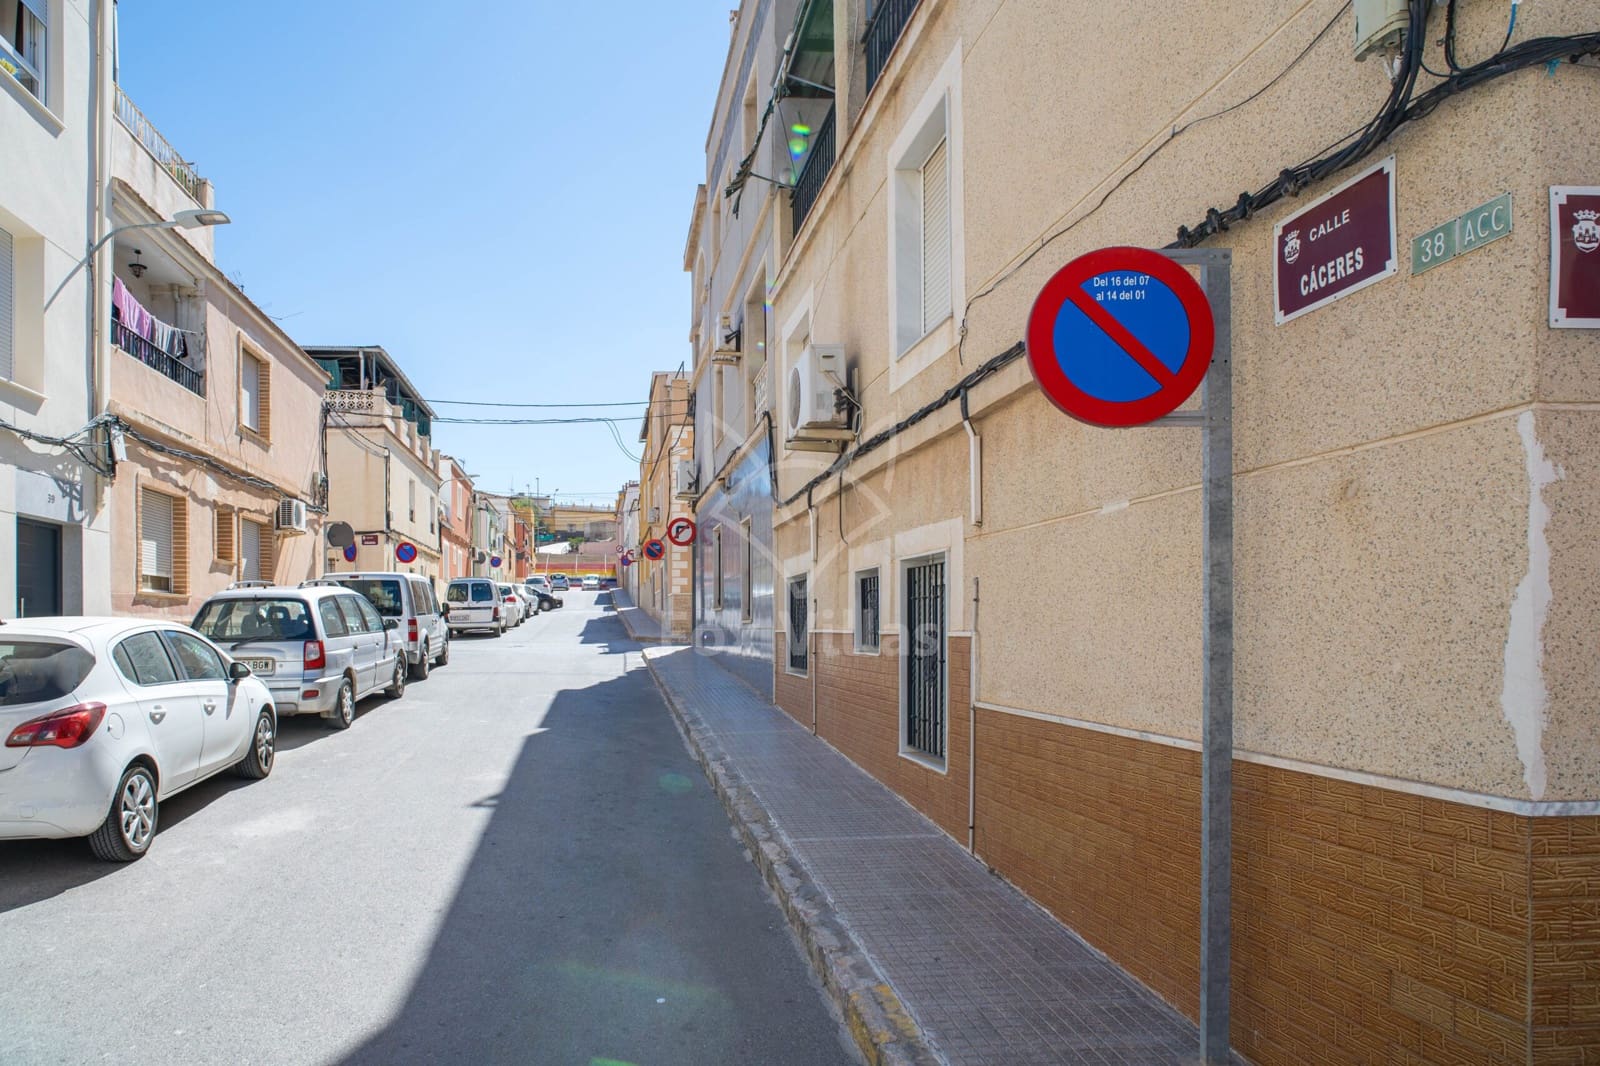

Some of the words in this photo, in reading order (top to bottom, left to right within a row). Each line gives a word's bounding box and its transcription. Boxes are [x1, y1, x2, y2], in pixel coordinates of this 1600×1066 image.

[1309, 209, 1350, 242] CALLE
[1421, 232, 1445, 263] 38
[1464, 206, 1504, 245] ACC
[1093, 276, 1108, 287] Del
[1111, 276, 1121, 286] 16
[1123, 276, 1137, 286] del
[1139, 275, 1150, 285] 07
[1300, 246, 1364, 296] CÁCERES
[1096, 291, 1104, 301] al
[1107, 290, 1117, 300] 14
[1120, 290, 1133, 300] del
[1135, 290, 1145, 300] 01
